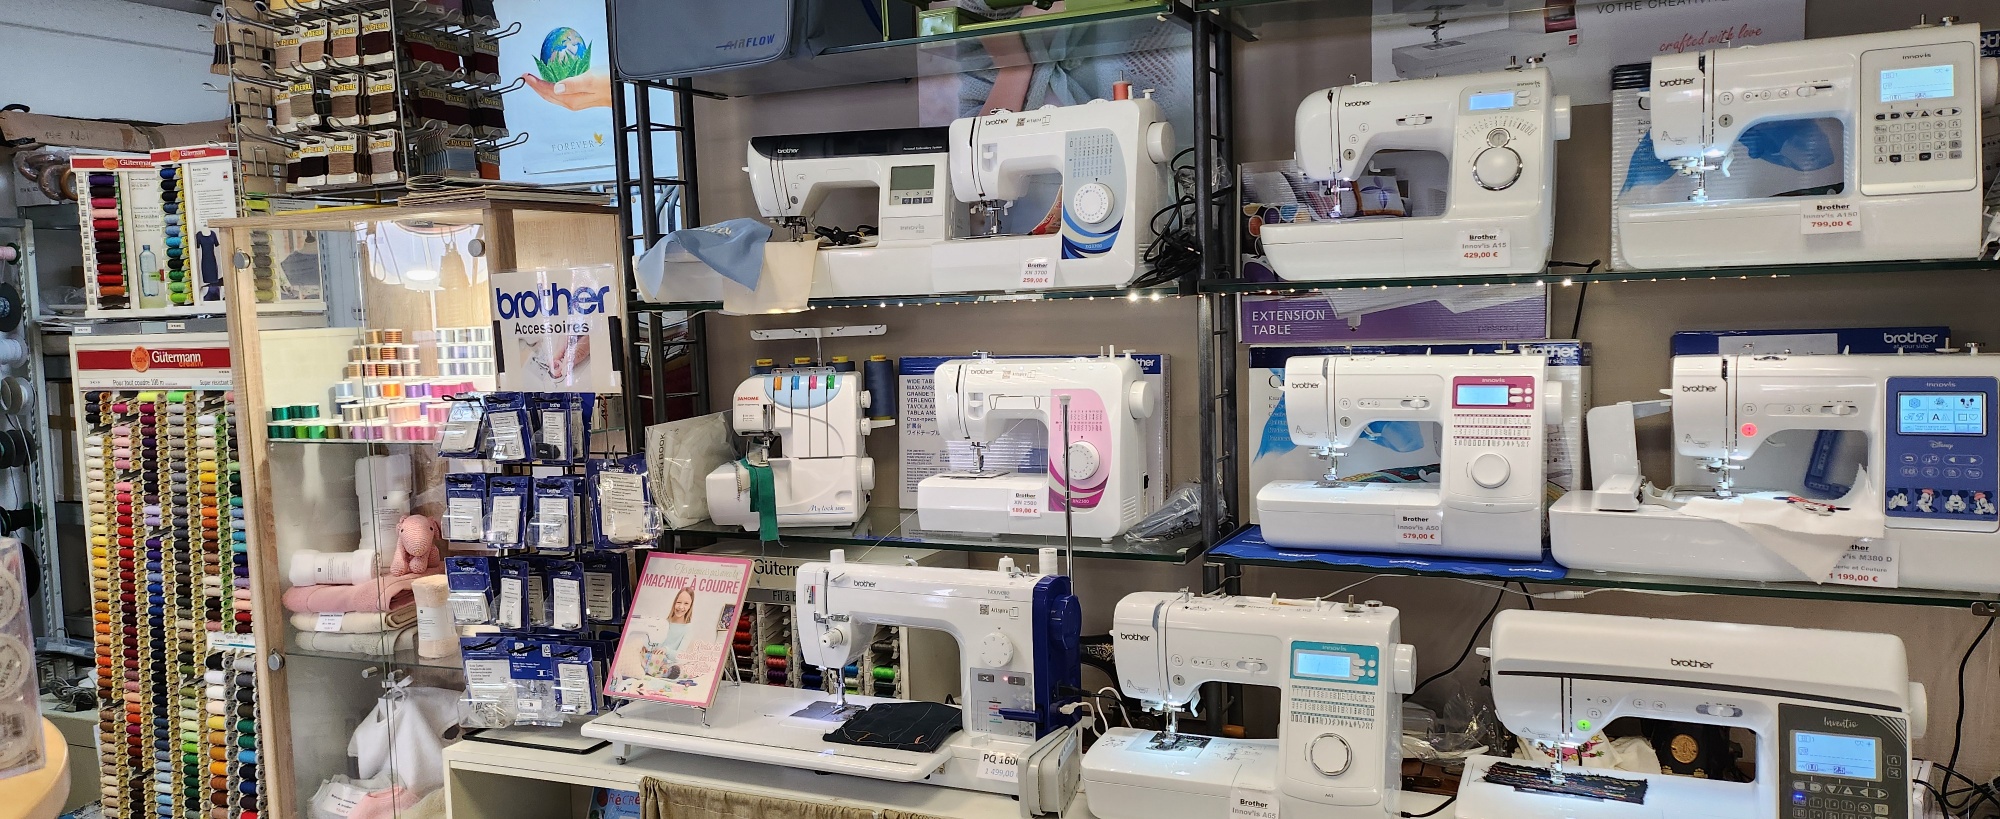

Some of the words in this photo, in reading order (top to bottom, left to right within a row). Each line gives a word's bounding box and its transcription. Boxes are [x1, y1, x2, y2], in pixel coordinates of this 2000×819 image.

[1596, 2, 1642, 14] VOTRE
[723, 34, 776, 50] AIRFLOW
[1660, 31, 1706, 53] crafted
[1708, 26, 1734, 44] with
[1738, 24, 1763, 40] love
[1660, 78, 1695, 87] brother
[1344, 100, 1372, 108] brother
[985, 118, 1008, 126] brother
[552, 140, 594, 152] FOREVER
[496, 282, 610, 320] brother
[1252, 310, 1325, 321] EXTENSION
[514, 320, 590, 334] Accessoires
[1252, 324, 1291, 335] TABLE
[1884, 332, 1938, 344] brother
[152, 350, 200, 363] Gütermann
[1682, 385, 1717, 393] brother
[1930, 440, 1954, 450] Disney
[1860, 554, 1883, 562] M380
[1838, 574, 1868, 582] 199,00
[643, 573, 689, 590] MACHINE
[690, 575, 697, 591] À
[698, 578, 740, 595] COUDRE
[854, 580, 876, 588] brother
[772, 590, 782, 601] Fil
[1120, 632, 1150, 642] brother
[1670, 658, 1714, 669] brother
[983, 754, 996, 764] PQ
[990, 768, 1014, 778] 499,00
[1240, 798, 1268, 808] Brother
